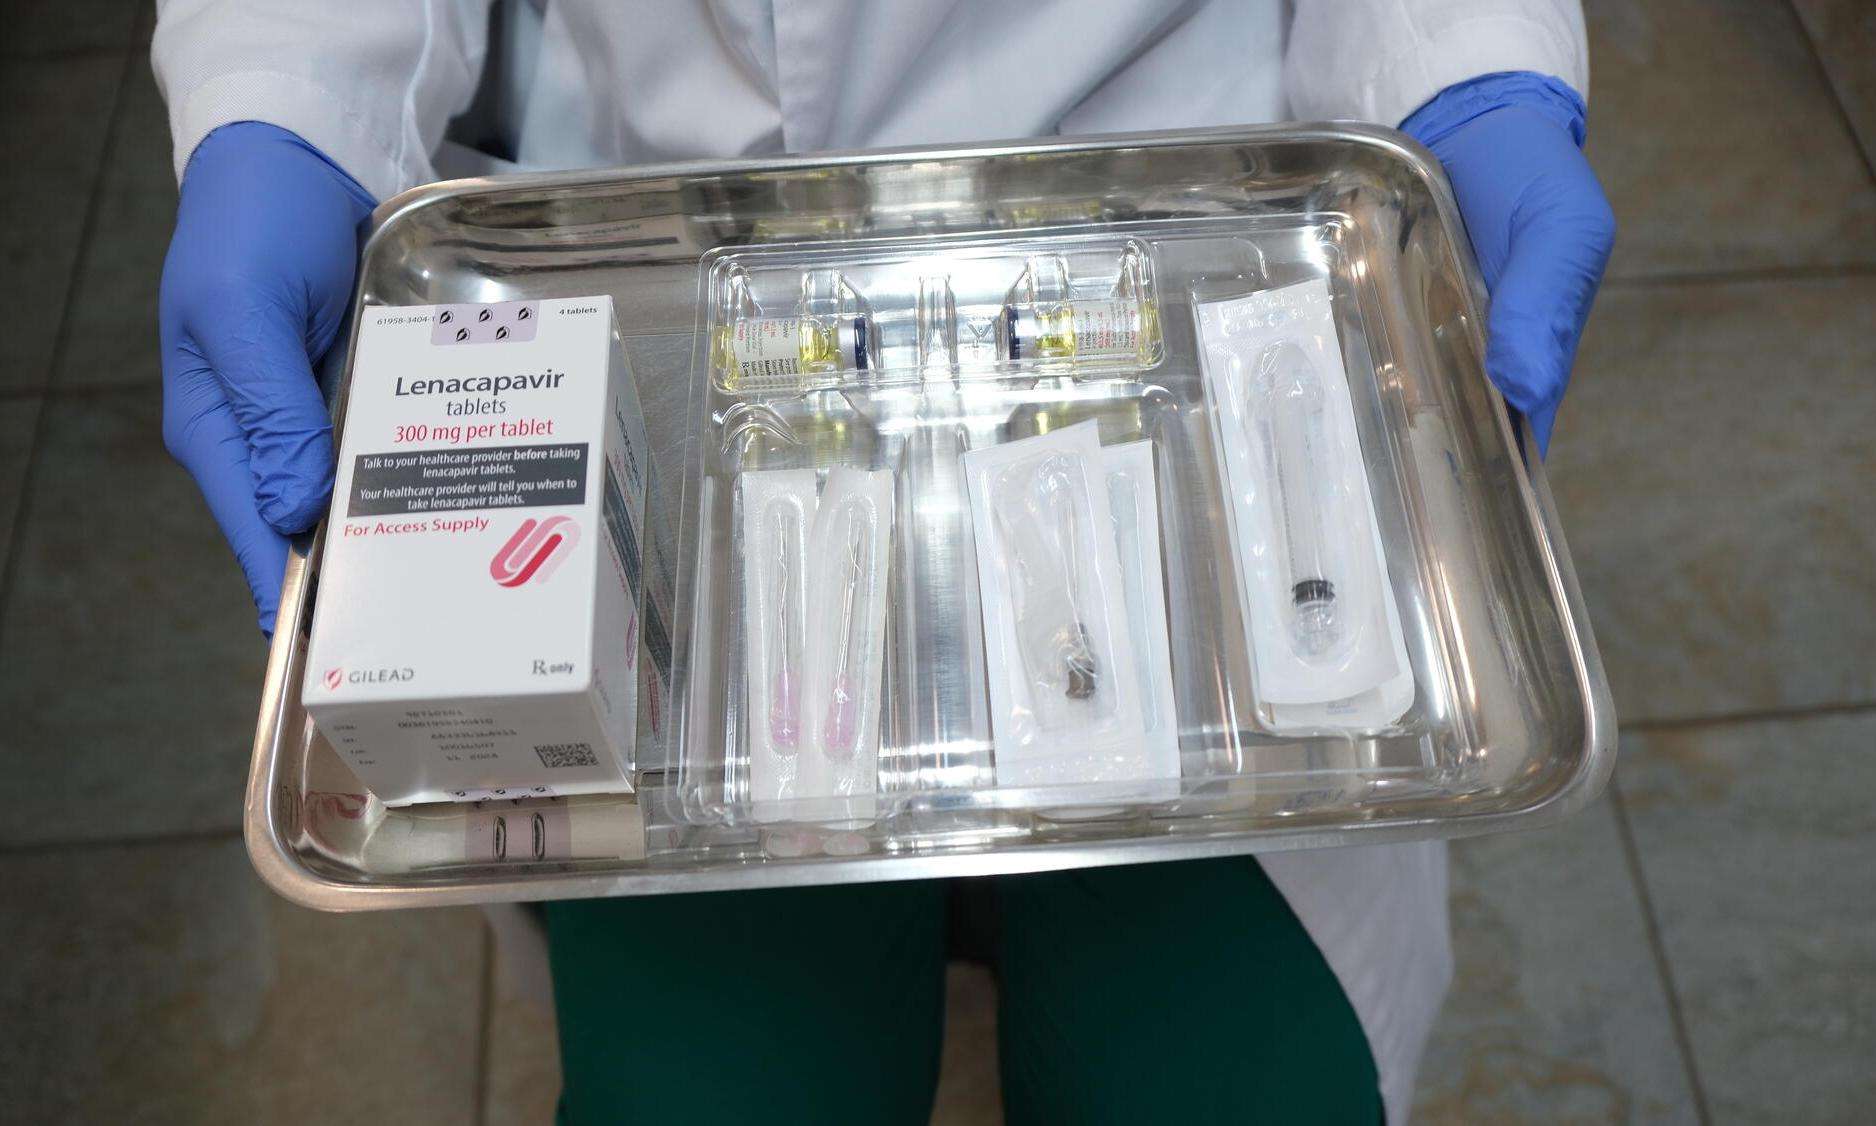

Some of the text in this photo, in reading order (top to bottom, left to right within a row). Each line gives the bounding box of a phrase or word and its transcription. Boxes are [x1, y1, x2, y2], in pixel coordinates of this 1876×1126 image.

[567, 307, 598, 315] tablets
[395, 368, 565, 397] Lenacapavir
[446, 398, 507, 417] tablets
[393, 418, 554, 444] 300 mg per tablet
[363, 448, 581, 469] Talk to your healthcare provider before taking
[422, 462, 516, 480] lenacapavir tablets.
[360, 478, 577, 500] Your healthcare provider will tell you when to
[407, 494, 525, 510] take lenacapavir tablets.
[344, 516, 490, 537] For Access Supply
[349, 669, 415, 683] GILEAD
[550, 663, 575, 675] only
